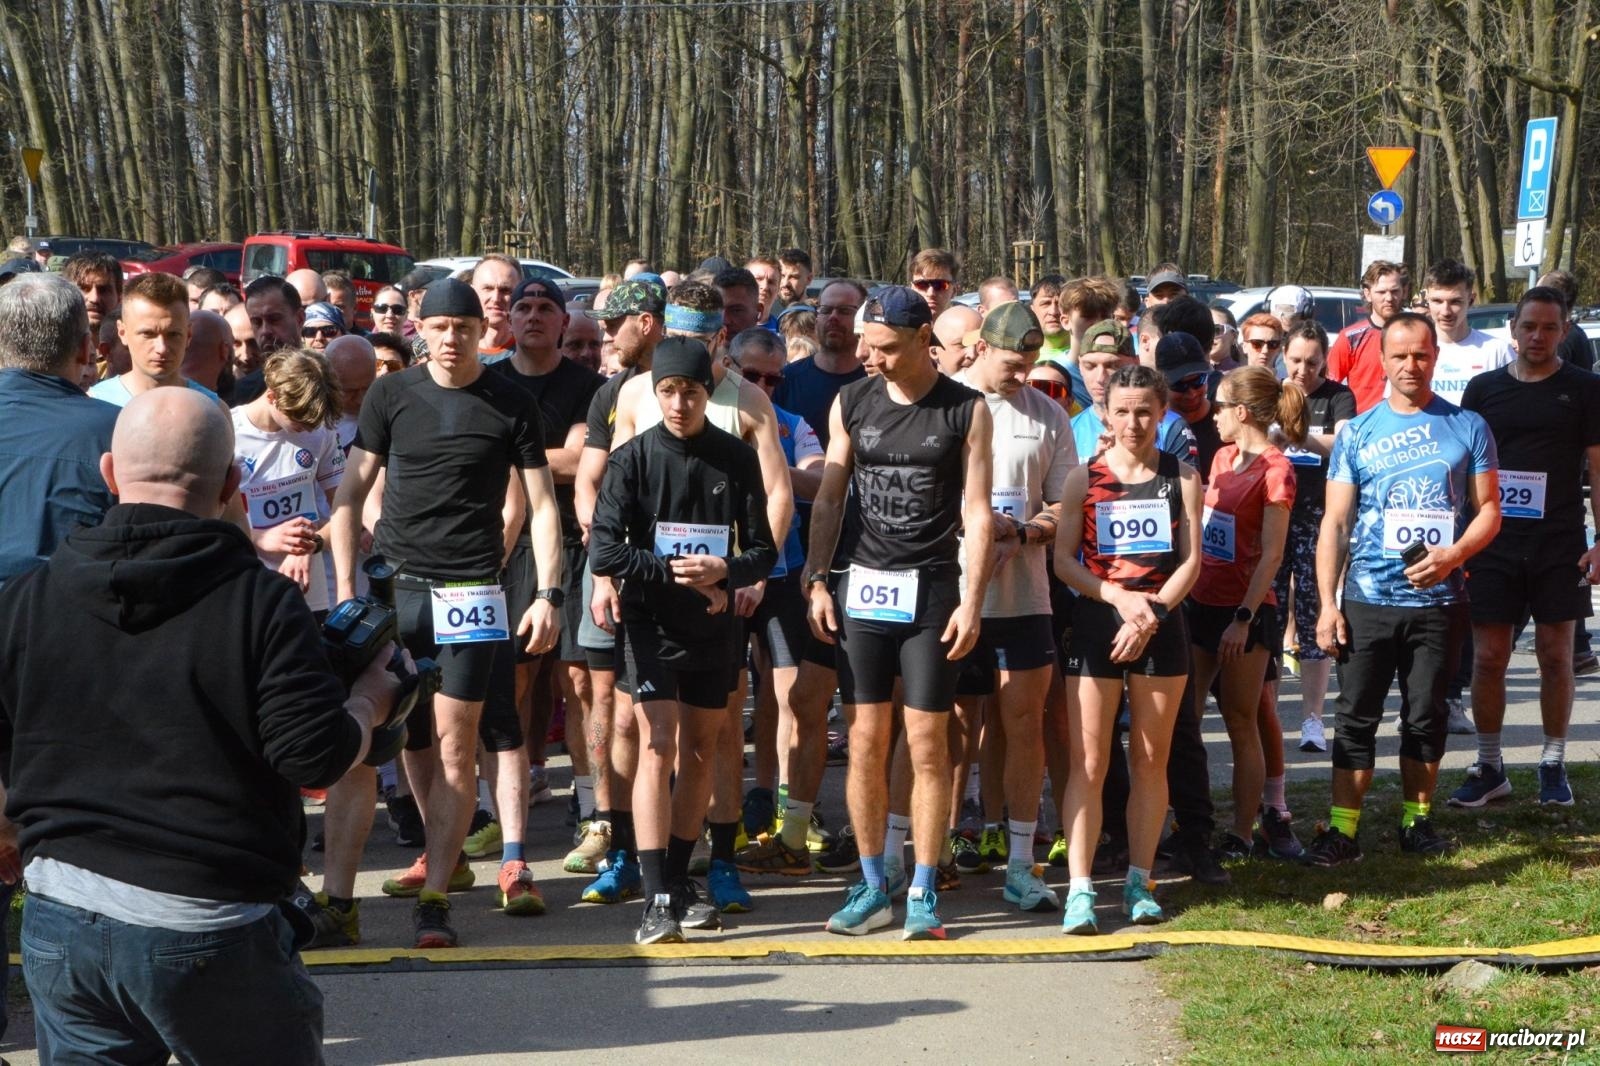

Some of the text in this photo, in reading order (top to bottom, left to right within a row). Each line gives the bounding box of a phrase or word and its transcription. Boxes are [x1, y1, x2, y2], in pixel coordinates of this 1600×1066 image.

[1526, 128, 1548, 189] P
[1359, 423, 1431, 464] MORSY
[1367, 441, 1441, 476] RACIBÓRZ
[263, 491, 303, 520] 037
[870, 493, 925, 520] BIEG
[1109, 518, 1158, 540] 090
[1204, 523, 1226, 547] 063
[1396, 526, 1441, 546] 030
[860, 584, 900, 607] 051
[447, 605, 496, 628] 043
